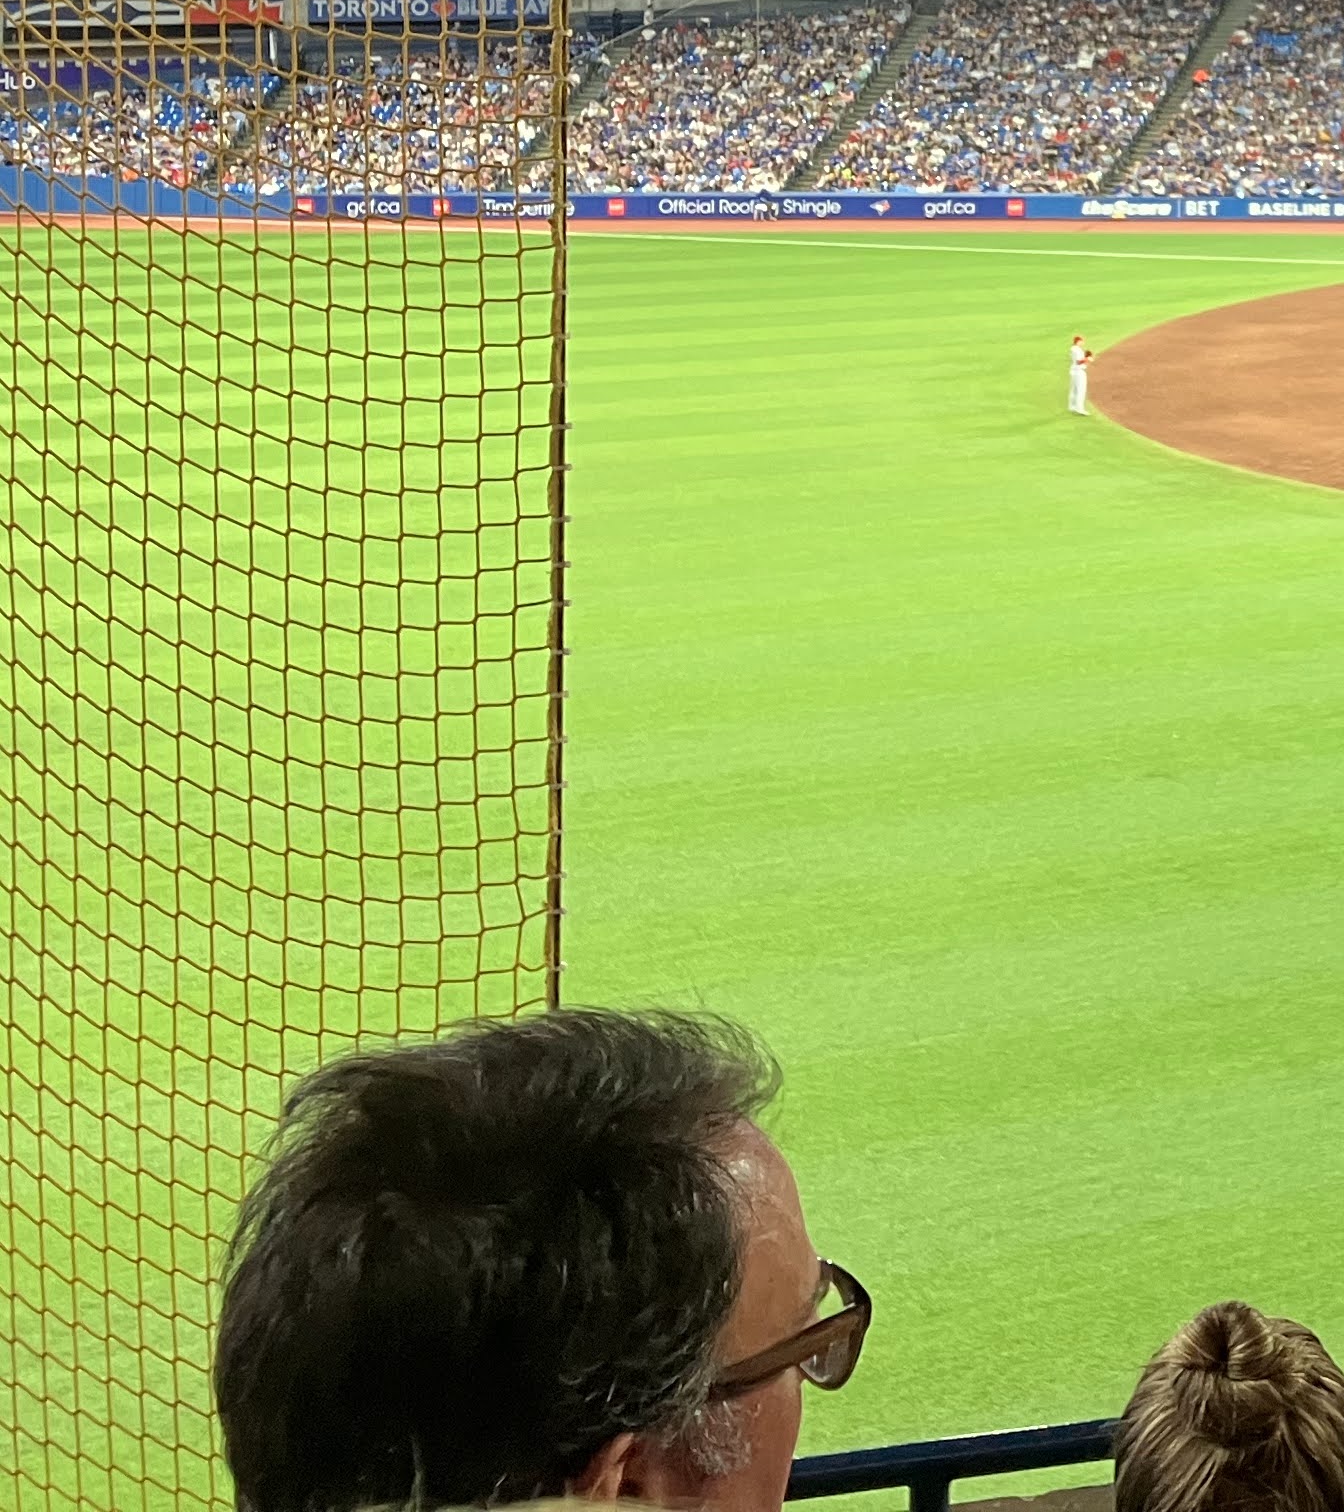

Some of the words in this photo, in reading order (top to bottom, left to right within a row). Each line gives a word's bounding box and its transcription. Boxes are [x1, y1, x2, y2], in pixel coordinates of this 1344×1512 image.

[313, 0, 429, 18] TORONTO
[658, 198, 714, 215] Official
[783, 198, 842, 218] Shingle
[924, 200, 976, 219] gaf.ca
[1186, 200, 1220, 217] BET
[1248, 202, 1331, 217] BASELINE
